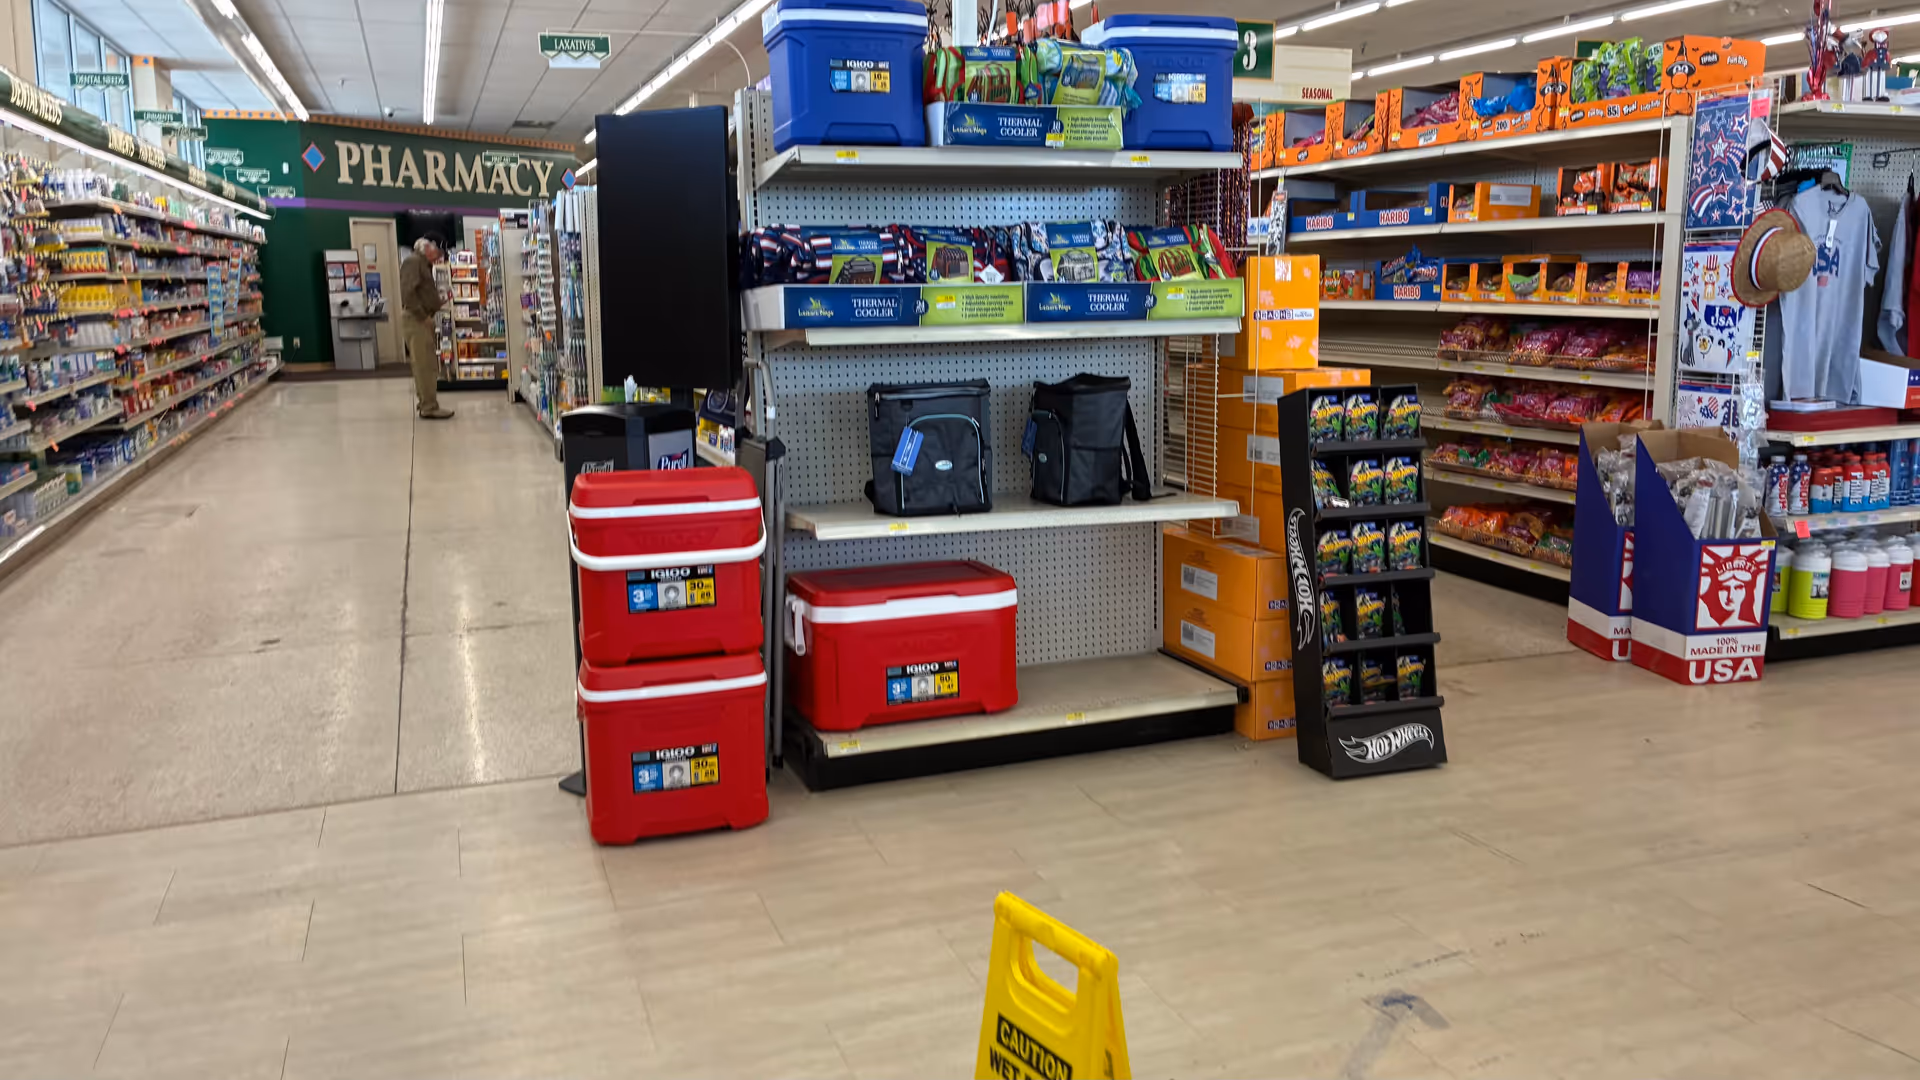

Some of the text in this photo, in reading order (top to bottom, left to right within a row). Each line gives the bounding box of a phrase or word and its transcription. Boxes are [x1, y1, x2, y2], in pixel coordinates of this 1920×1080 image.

[554, 38, 596, 50] LAXATIVES
[1243, 30, 1257, 71] 3
[847, 59, 874, 69] IGLOO
[1302, 86, 1333, 100] SEASONAL
[10, 78, 63, 126] DENTAL NEEDS
[998, 116, 1042, 128] THERMAL
[1000, 127, 1038, 137] COOLER
[334, 140, 554, 198] PHARMACY
[1306, 216, 1334, 231] HARIBO
[1379, 209, 1410, 225] HARIBO
[1812, 243, 1840, 278] SA
[1088, 294, 1130, 303] THERMAL
[1394, 284, 1420, 300] HARIBO
[852, 298, 898, 308] THERMAL
[1090, 302, 1126, 312] COOLER
[854, 308, 894, 318] COOLER
[1710, 316, 1734, 326] USA
[1850, 472, 1864, 505] PRIME
[650, 566, 691, 580] IGLOO
[1716, 558, 1757, 574] LIBERTY
[690, 580, 704, 591] 30
[632, 588, 645, 604] 3
[1613, 628, 1632, 636] MA
[1716, 637, 1738, 646] 100%
[1690, 644, 1762, 656] MADE IN THE
[906, 662, 940, 675] IGLOO
[1688, 658, 1758, 684] USA
[656, 746, 695, 760] IGLOO
[638, 770, 650, 785] 3
[1000, 1020, 1069, 1080] CAUTION
[990, 1045, 1020, 1080] WET
